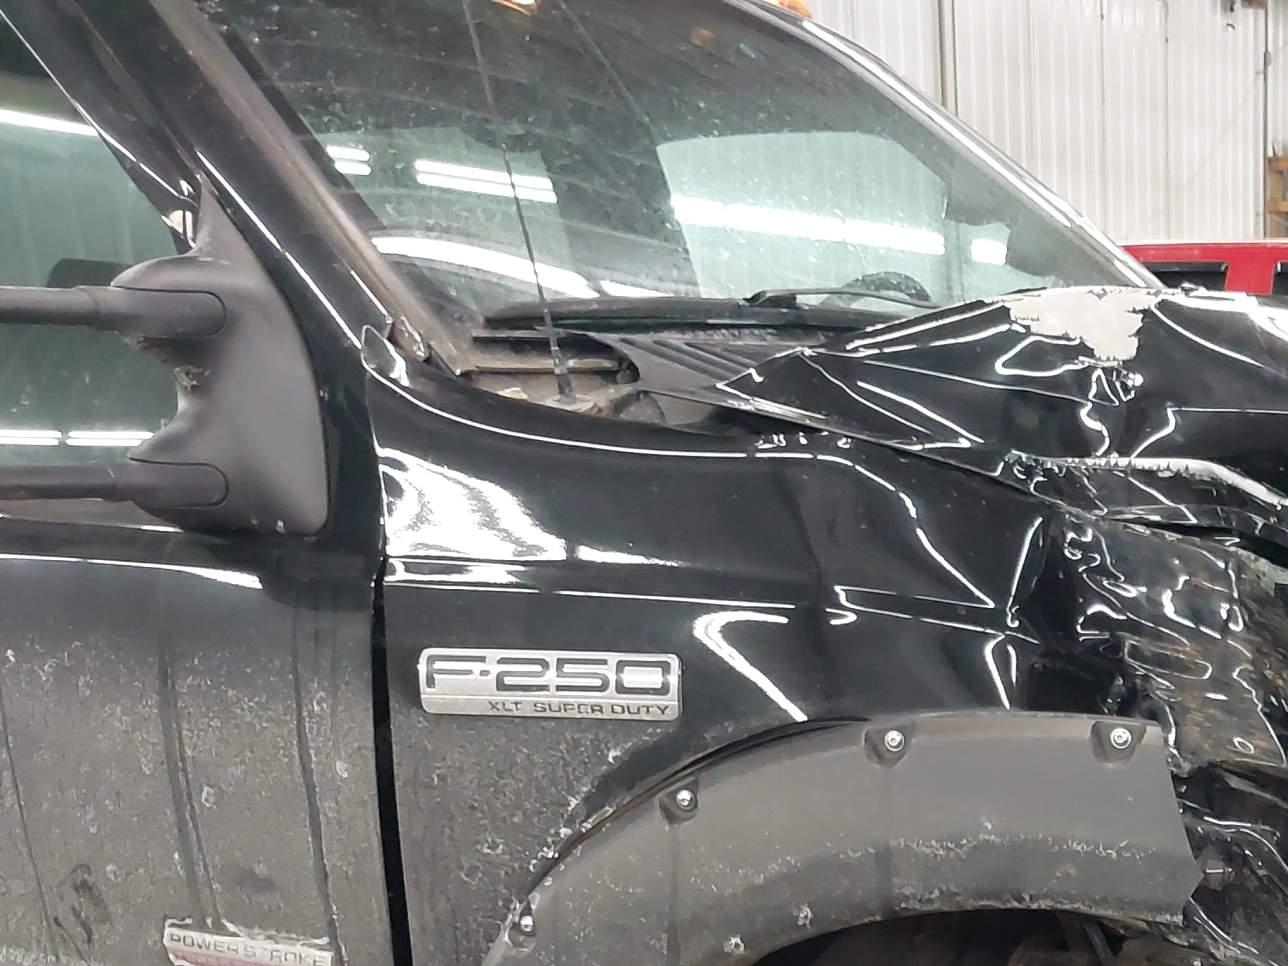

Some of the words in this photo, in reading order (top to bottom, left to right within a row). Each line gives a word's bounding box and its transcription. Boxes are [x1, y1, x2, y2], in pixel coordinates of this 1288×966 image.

[426, 654, 672, 696] F-250
[487, 700, 523, 713] XLT
[533, 702, 604, 715] SUPER
[611, 703, 670, 716] DUTY
